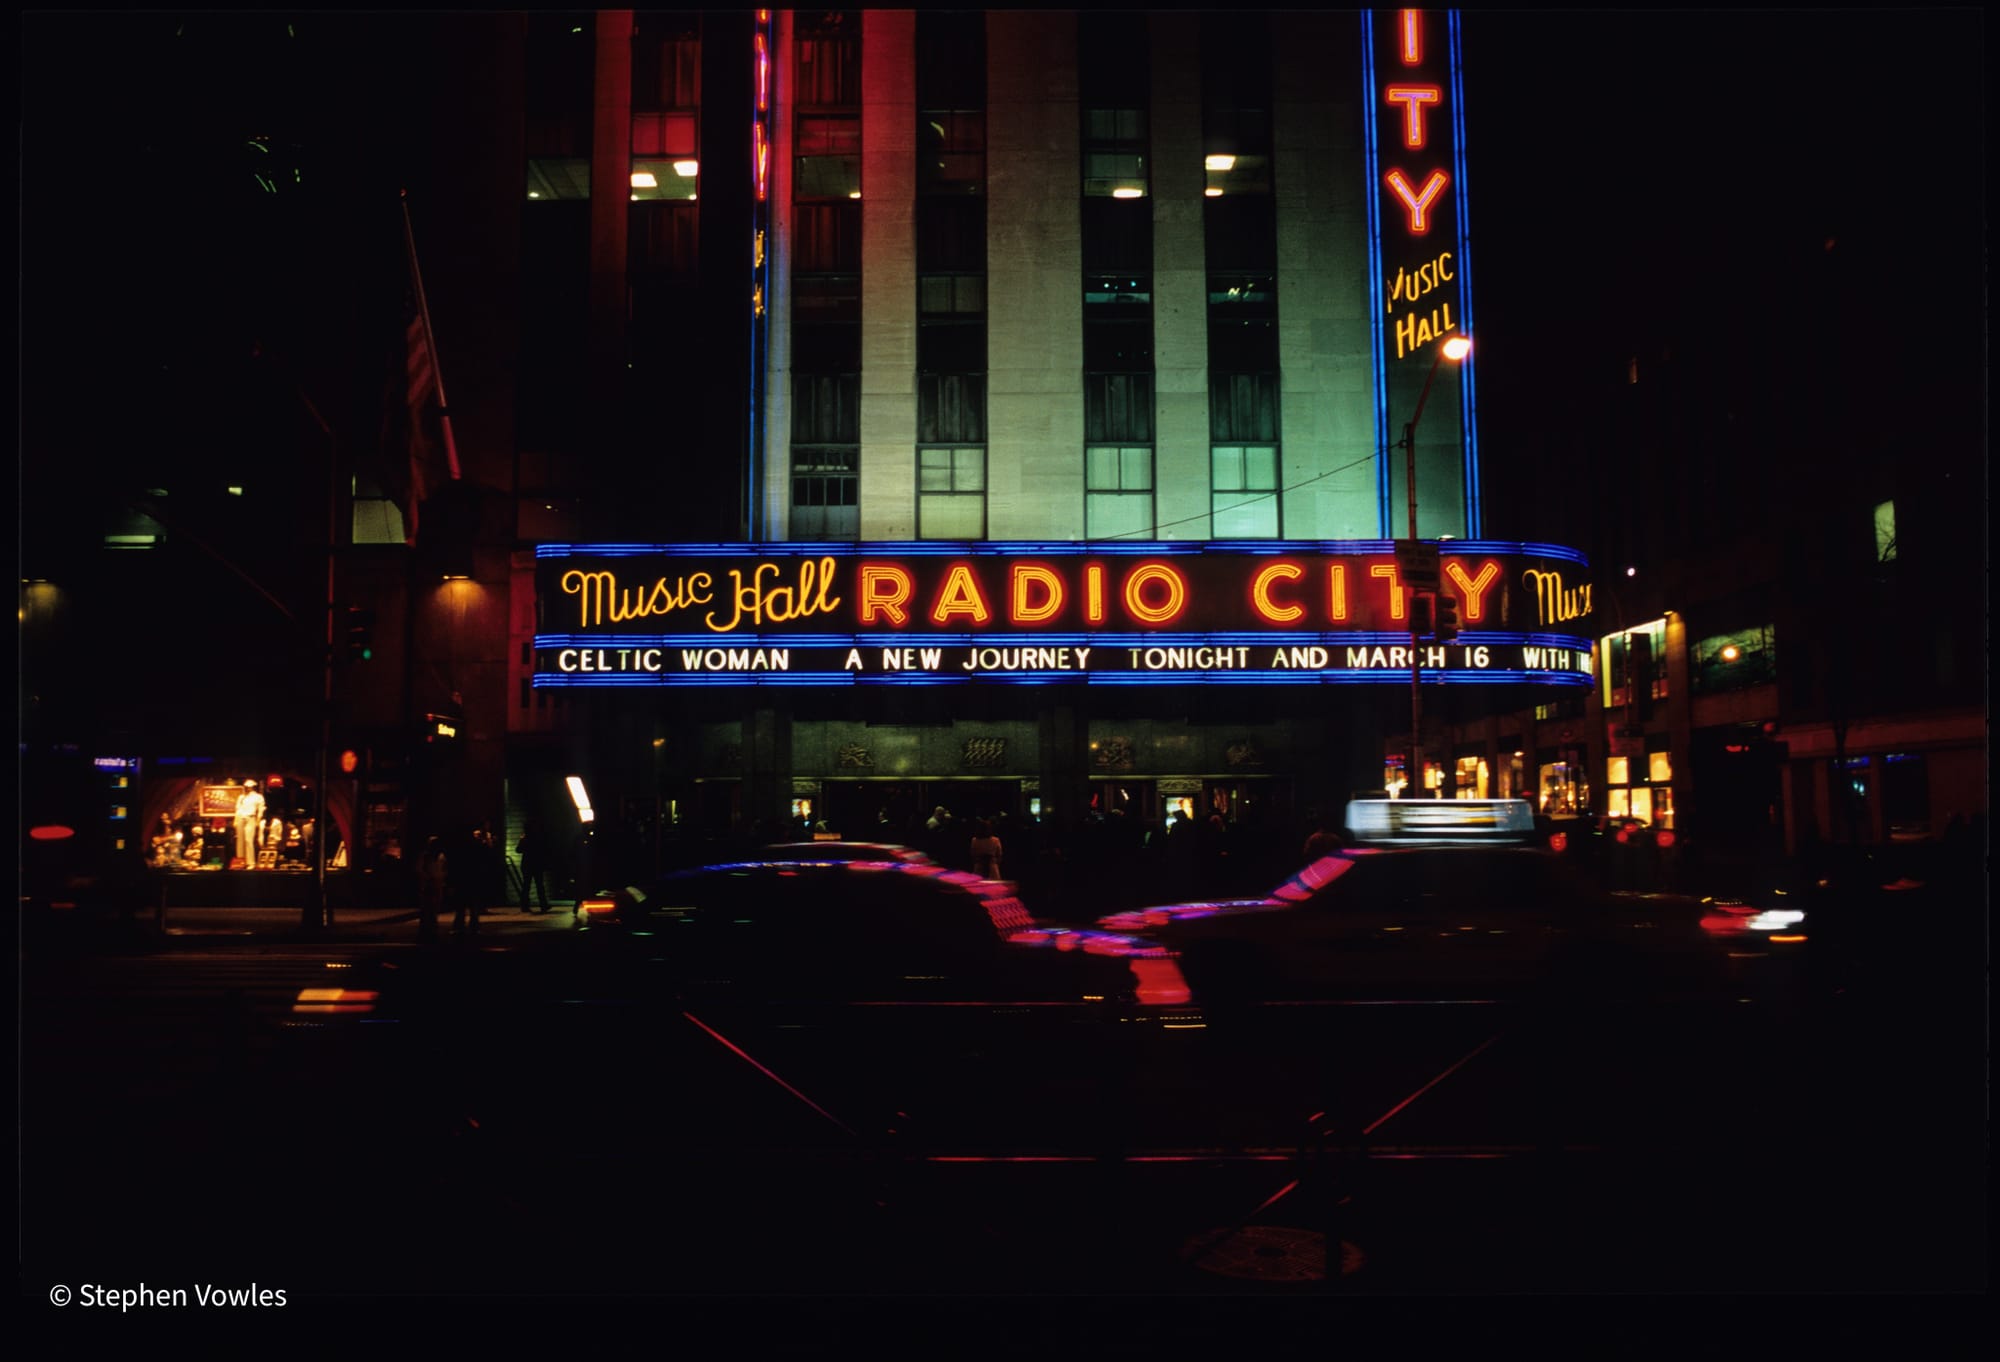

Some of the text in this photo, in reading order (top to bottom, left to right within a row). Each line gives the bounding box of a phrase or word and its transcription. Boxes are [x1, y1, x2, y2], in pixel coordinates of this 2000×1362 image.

[1387, 252, 1454, 314] MUSIC
[1396, 302, 1456, 360] HALL
[561, 556, 841, 632] Music Hall
[861, 563, 1185, 625] RADIO
[1253, 561, 1498, 622] CITY
[558, 648, 662, 672] CELTIC
[682, 648, 789, 671] WOMAN
[844, 648, 864, 671] A
[883, 647, 942, 670] NEW
[962, 646, 1091, 671] JOURNEY
[1128, 646, 1250, 669] TONIGHT
[1271, 646, 1329, 669] AND
[1347, 645, 1446, 669] MARCH
[1464, 645, 1490, 669] 16
[1522, 647, 1570, 670] WITH
